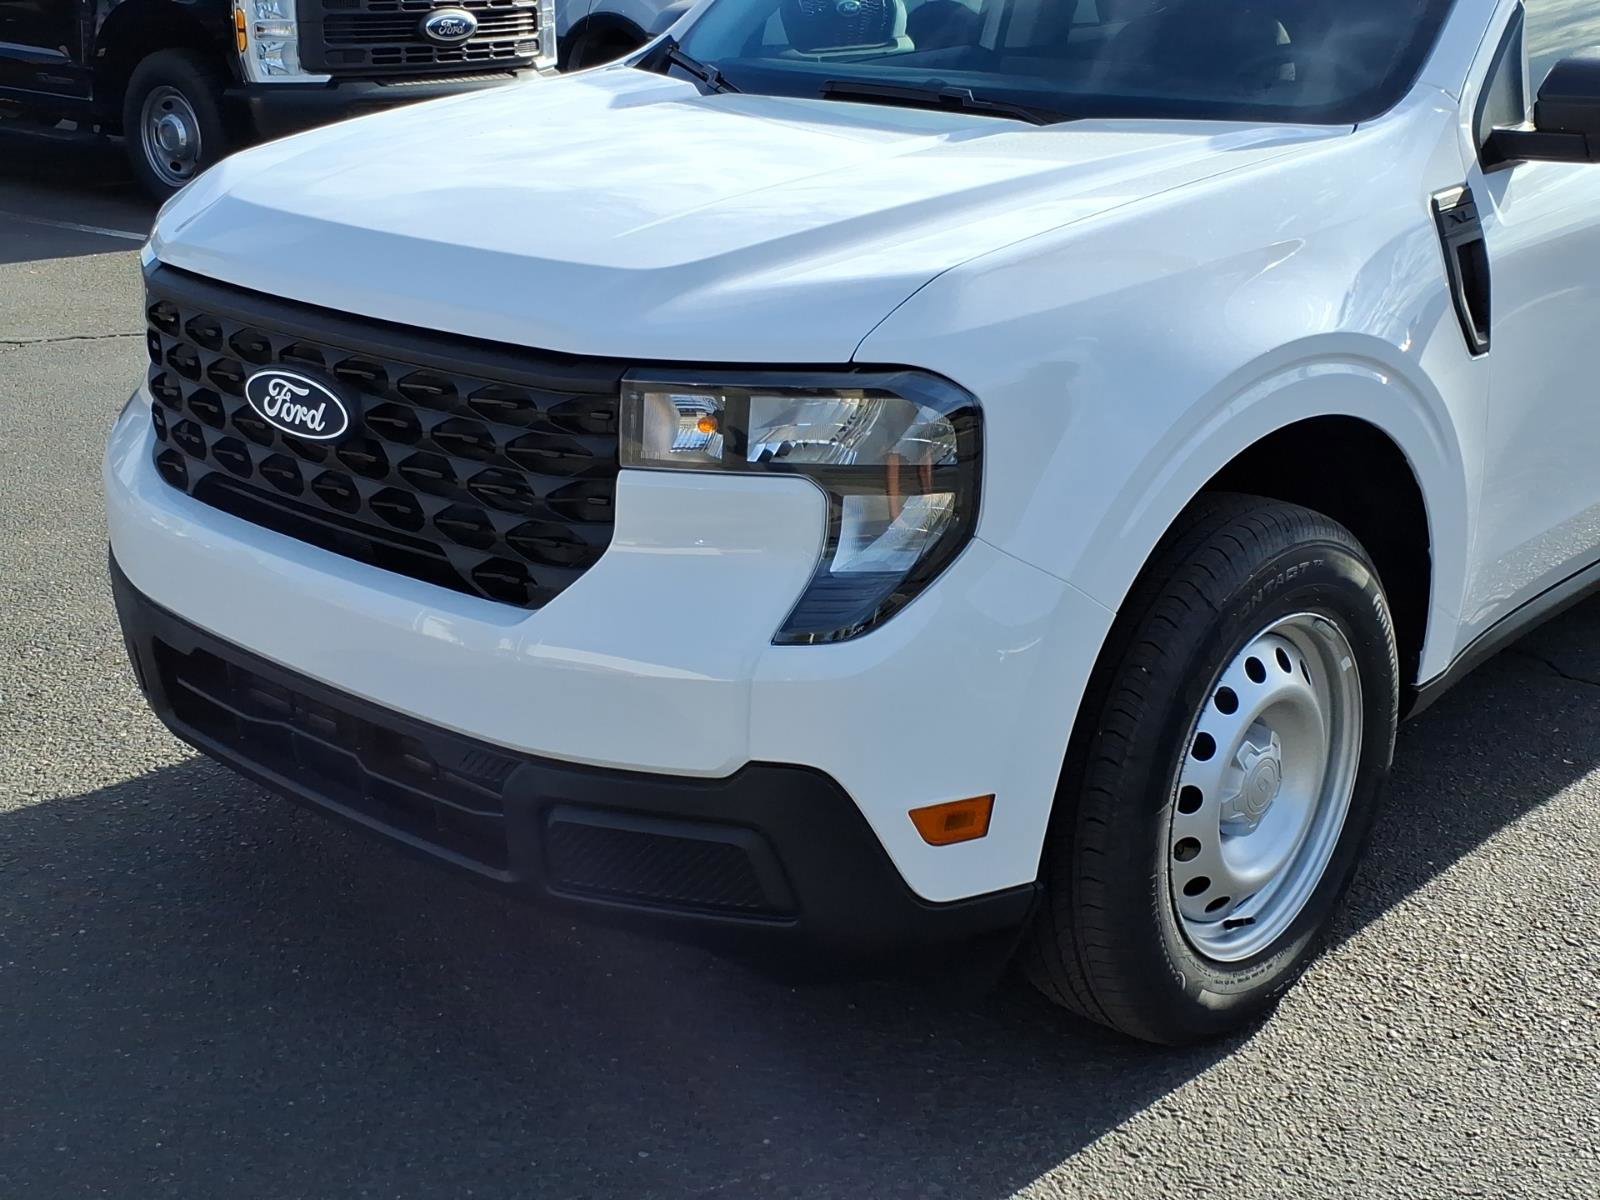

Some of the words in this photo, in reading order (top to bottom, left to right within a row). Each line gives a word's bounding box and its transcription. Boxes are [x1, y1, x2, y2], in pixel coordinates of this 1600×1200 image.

[438, 19, 466, 35] Ford
[1446, 209, 1477, 229] XL
[263, 378, 327, 432] Ford
